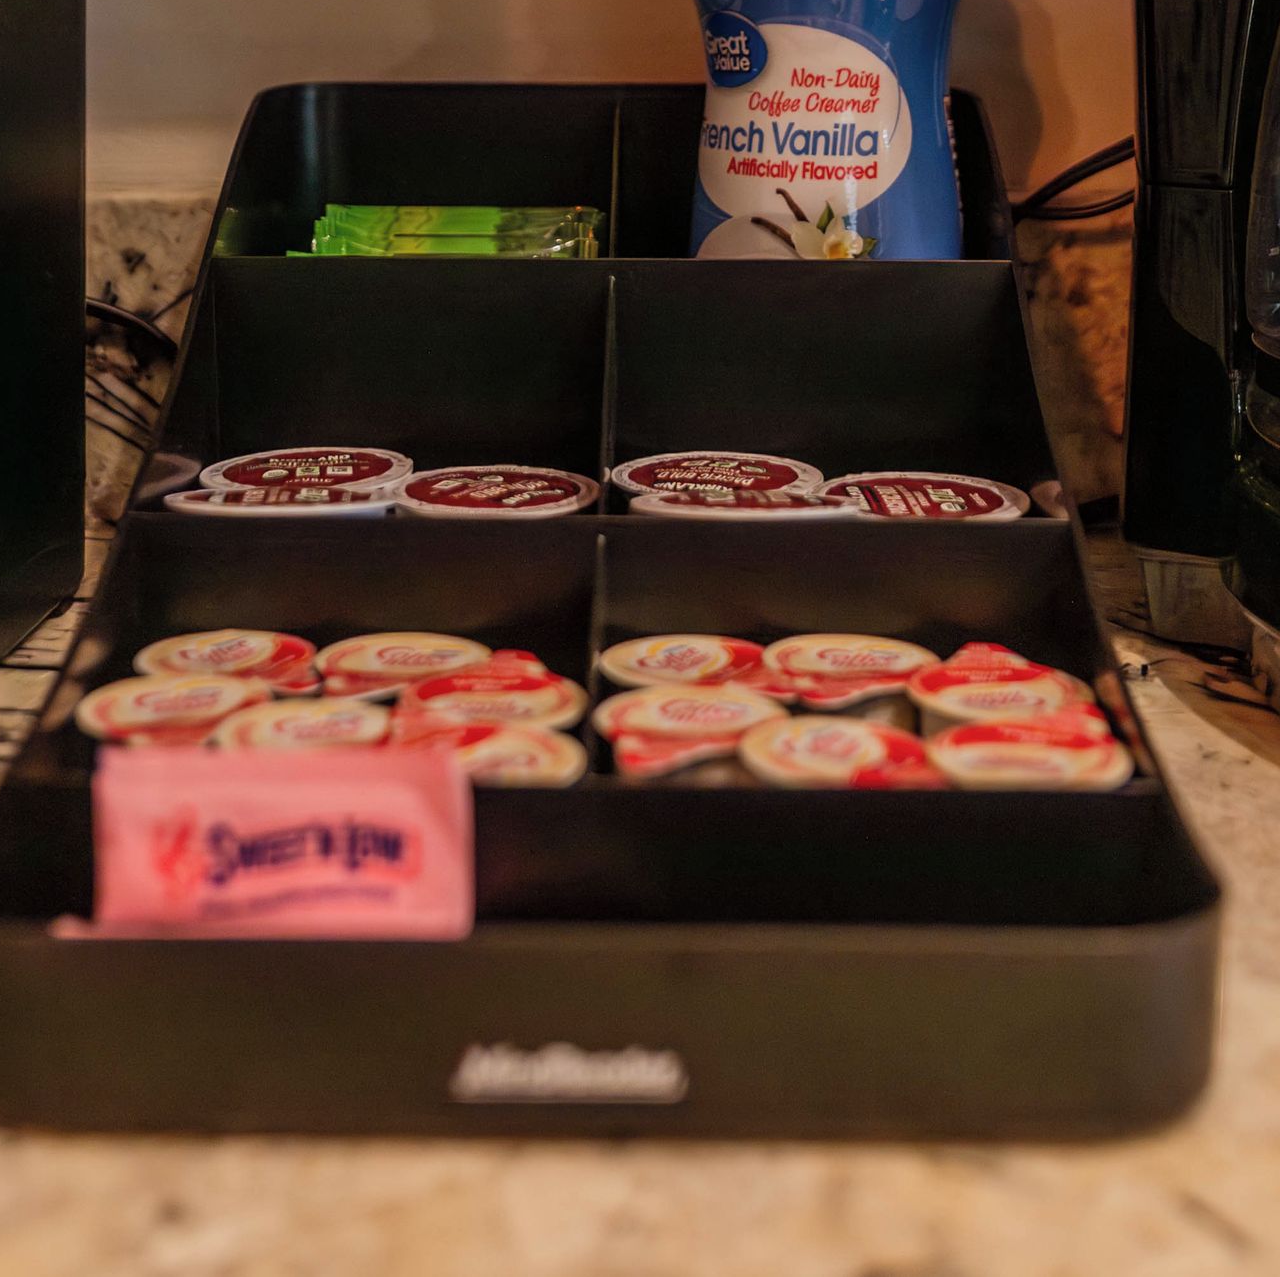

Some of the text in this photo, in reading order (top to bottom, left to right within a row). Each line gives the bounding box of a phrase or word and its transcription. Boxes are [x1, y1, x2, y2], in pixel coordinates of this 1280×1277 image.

[706, 29, 750, 55] Great
[714, 54, 751, 72] Value
[790, 67, 881, 96] Non-Dairy
[748, 90, 880, 117] Coffee Creamer
[700, 120, 879, 157] rench Vanilla
[726, 157, 878, 183] Artificially Flavored
